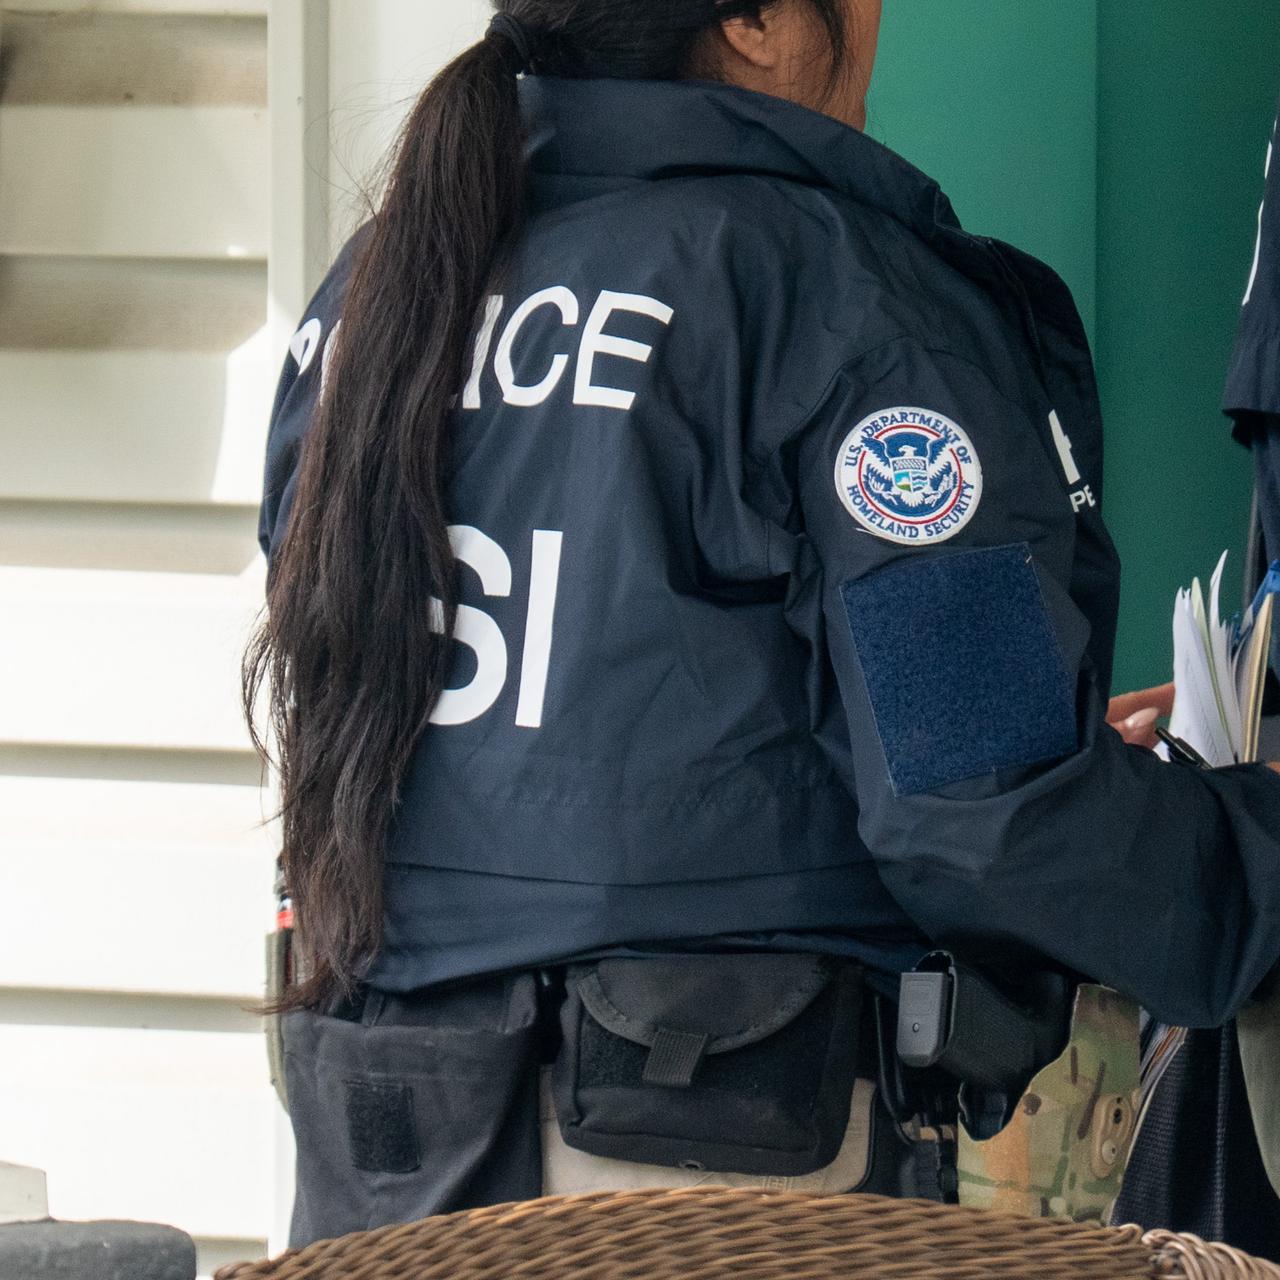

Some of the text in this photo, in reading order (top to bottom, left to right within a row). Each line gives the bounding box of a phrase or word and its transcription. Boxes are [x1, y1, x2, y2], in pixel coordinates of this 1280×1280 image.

[289, 285, 674, 410] PICE
[844, 411, 973, 468] U.S. DEPARTMENT OF
[846, 480, 975, 539] HOMELAND SECURITY
[427, 524, 563, 728] SI
